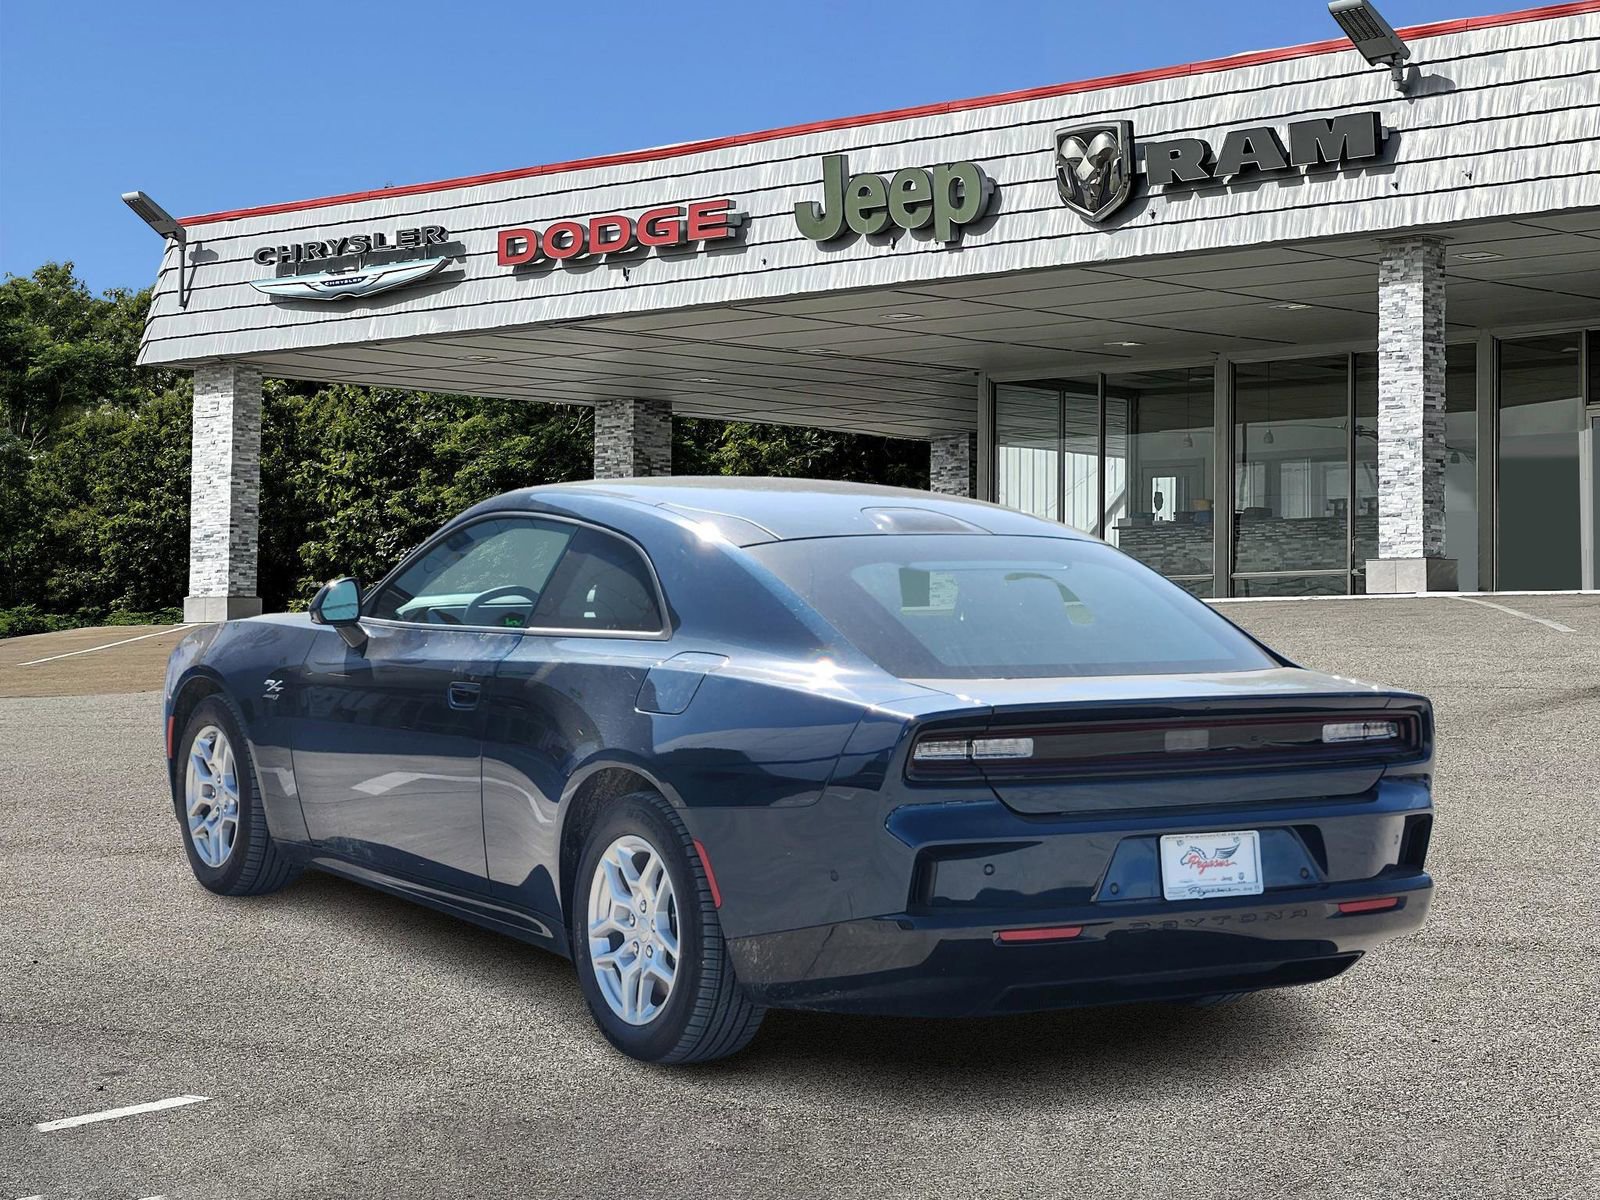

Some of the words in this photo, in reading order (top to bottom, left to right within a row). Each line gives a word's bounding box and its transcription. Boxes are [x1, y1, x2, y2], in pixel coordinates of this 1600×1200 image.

[1145, 111, 1384, 187] RAM
[795, 154, 994, 243] Jeep
[253, 224, 449, 267] CHRYSLER
[497, 198, 741, 267] DODGE
[1187, 855, 1237, 875] Pegasus
[1127, 908, 1308, 934] DAYTONA
